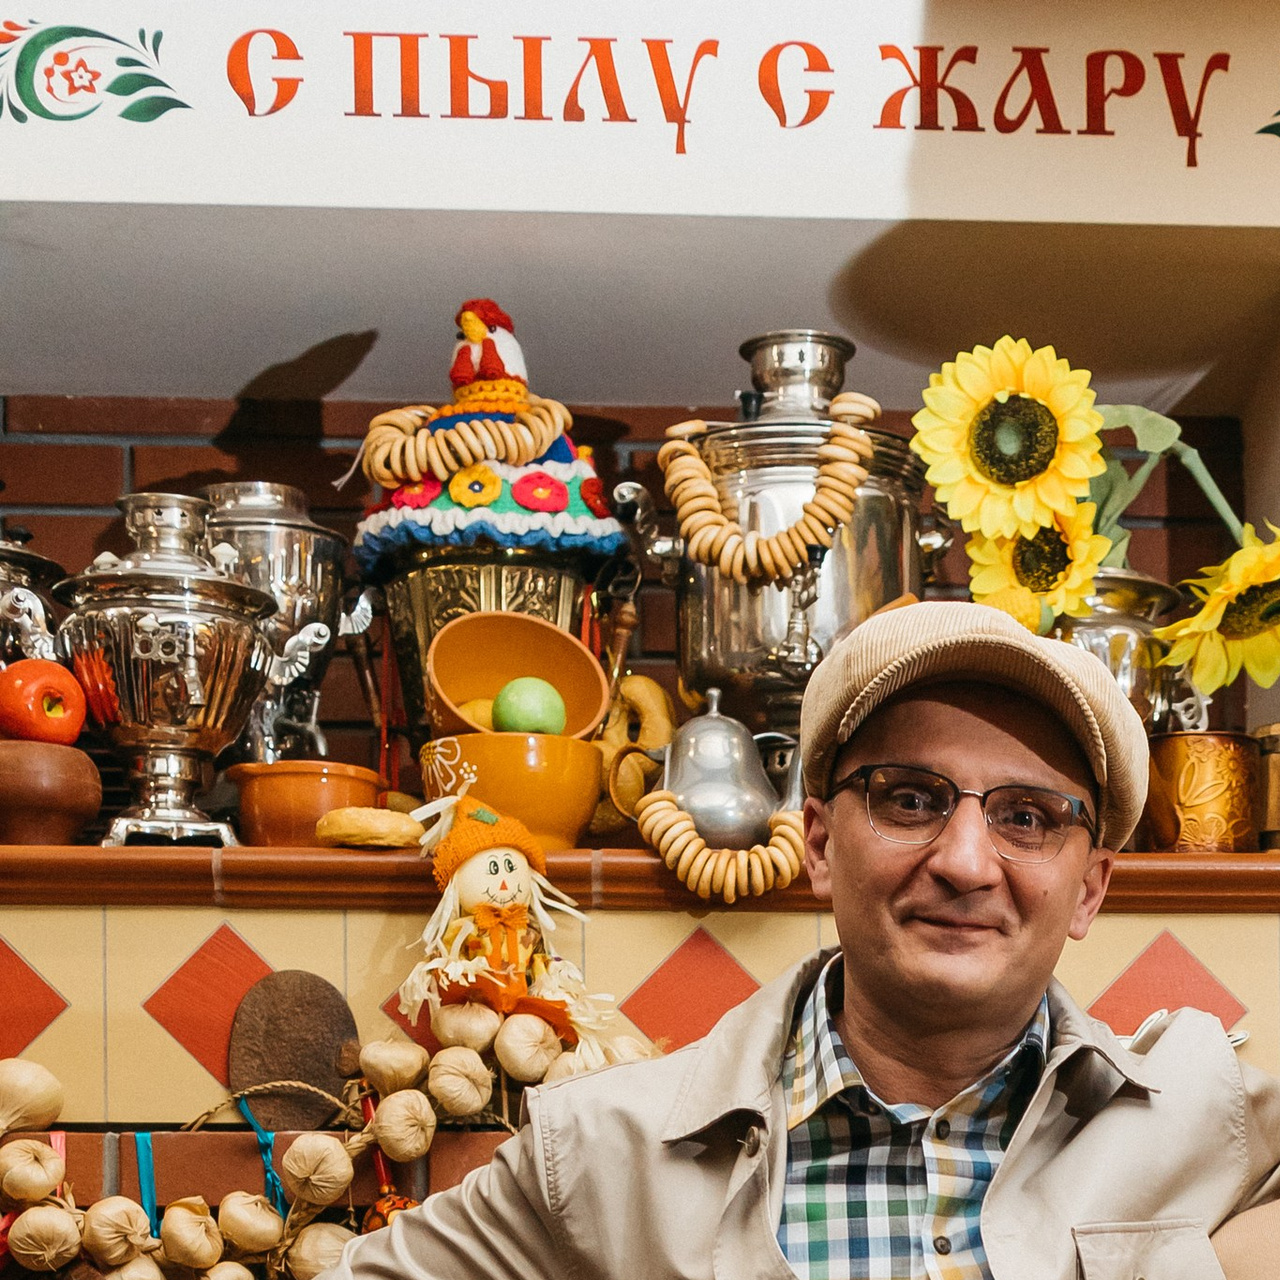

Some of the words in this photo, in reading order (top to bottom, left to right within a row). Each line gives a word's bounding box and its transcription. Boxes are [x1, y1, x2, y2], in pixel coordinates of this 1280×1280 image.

[226, 29, 303, 118] С
[344, 31, 719, 155] ПЫЛУ
[758, 41, 834, 129] С
[873, 45, 1231, 168] ЖАРУ
